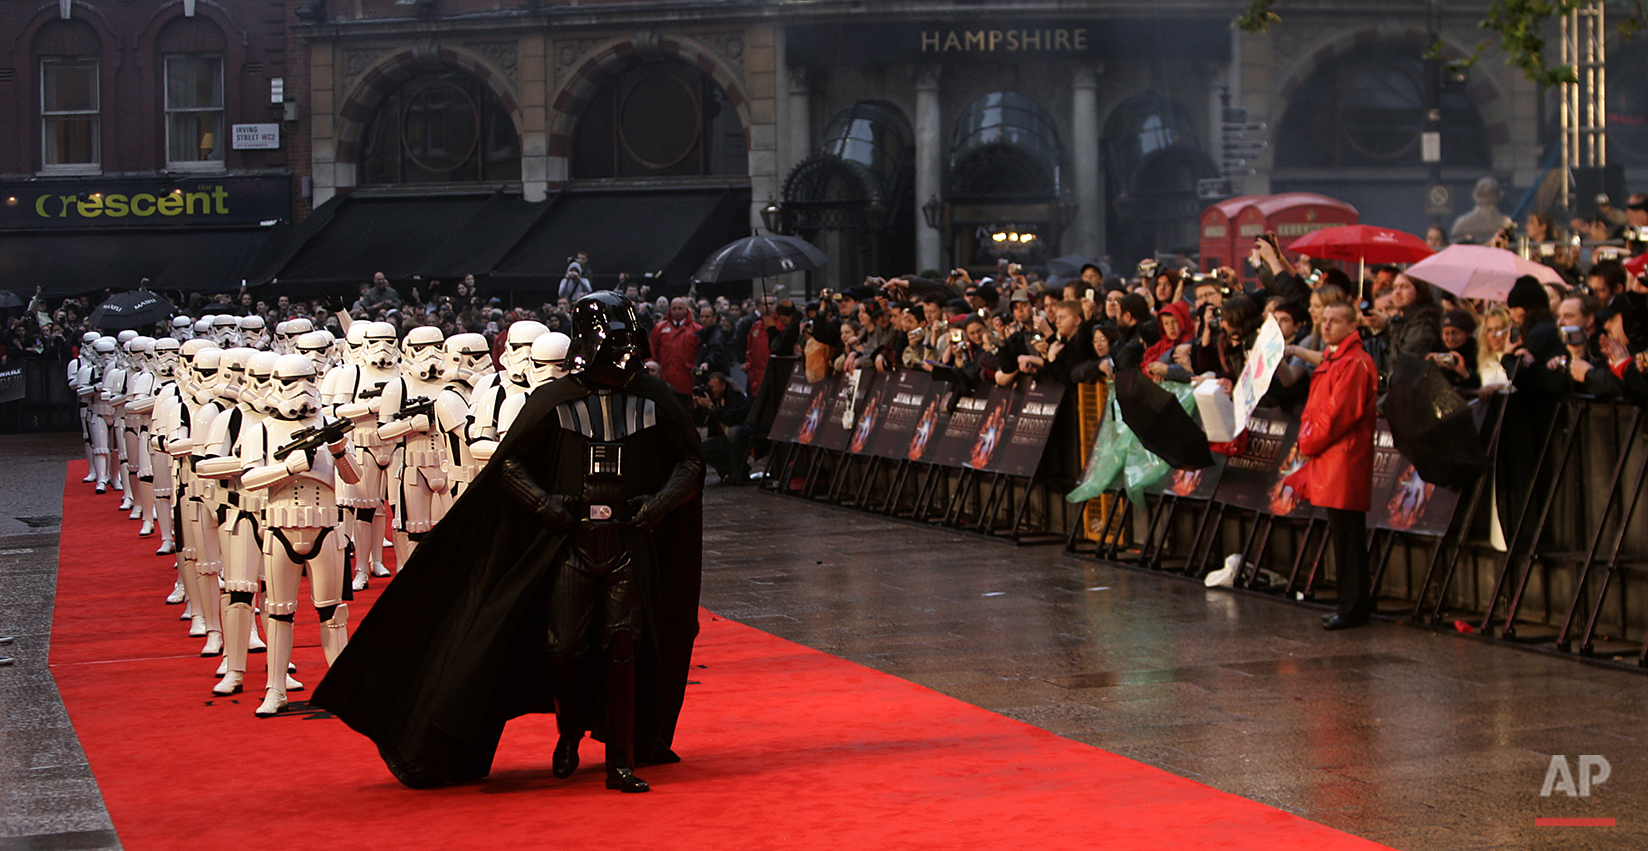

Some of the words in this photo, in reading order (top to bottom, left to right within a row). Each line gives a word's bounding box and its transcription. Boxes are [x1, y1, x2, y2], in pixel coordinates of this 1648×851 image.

[921, 29, 1088, 50] HAMPSHIRE
[261, 133, 275, 141] WC2
[35, 185, 229, 218] crescent
[1248, 437, 1276, 458] SODE
